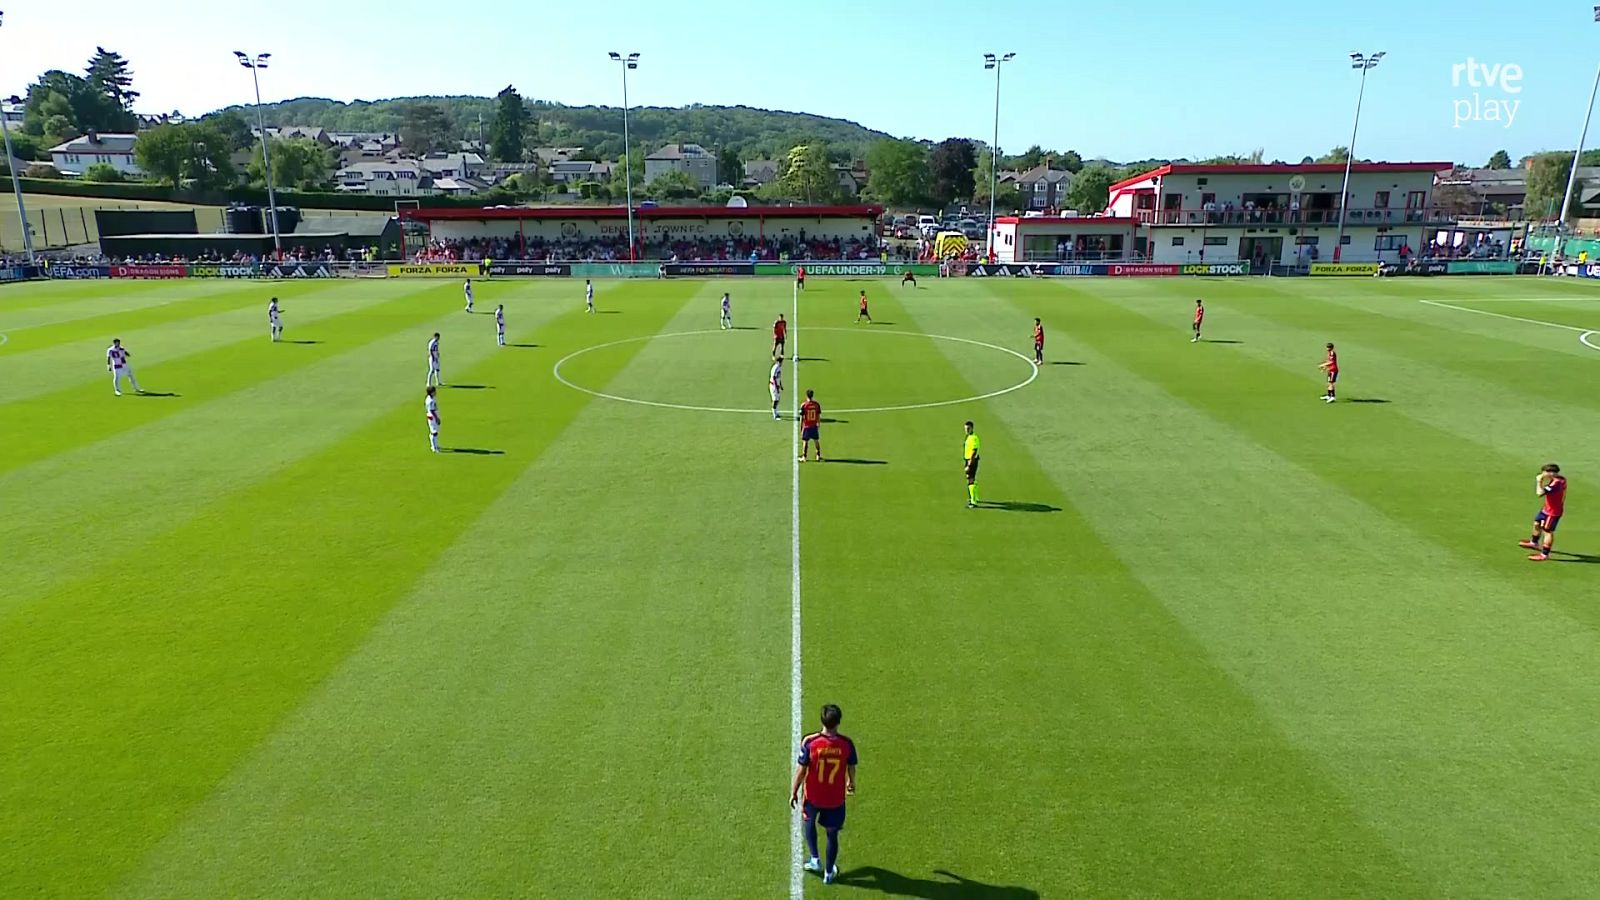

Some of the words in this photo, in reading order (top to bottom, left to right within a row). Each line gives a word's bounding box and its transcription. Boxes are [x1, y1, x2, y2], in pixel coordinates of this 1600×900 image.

[400, 266, 432, 274] FORZA
[435, 266, 468, 274] FORZA
[807, 265, 836, 275] UEFA
[836, 265, 886, 275] UNDER-19
[1345, 265, 1373, 273] FORZA
[817, 758, 841, 785] 17
